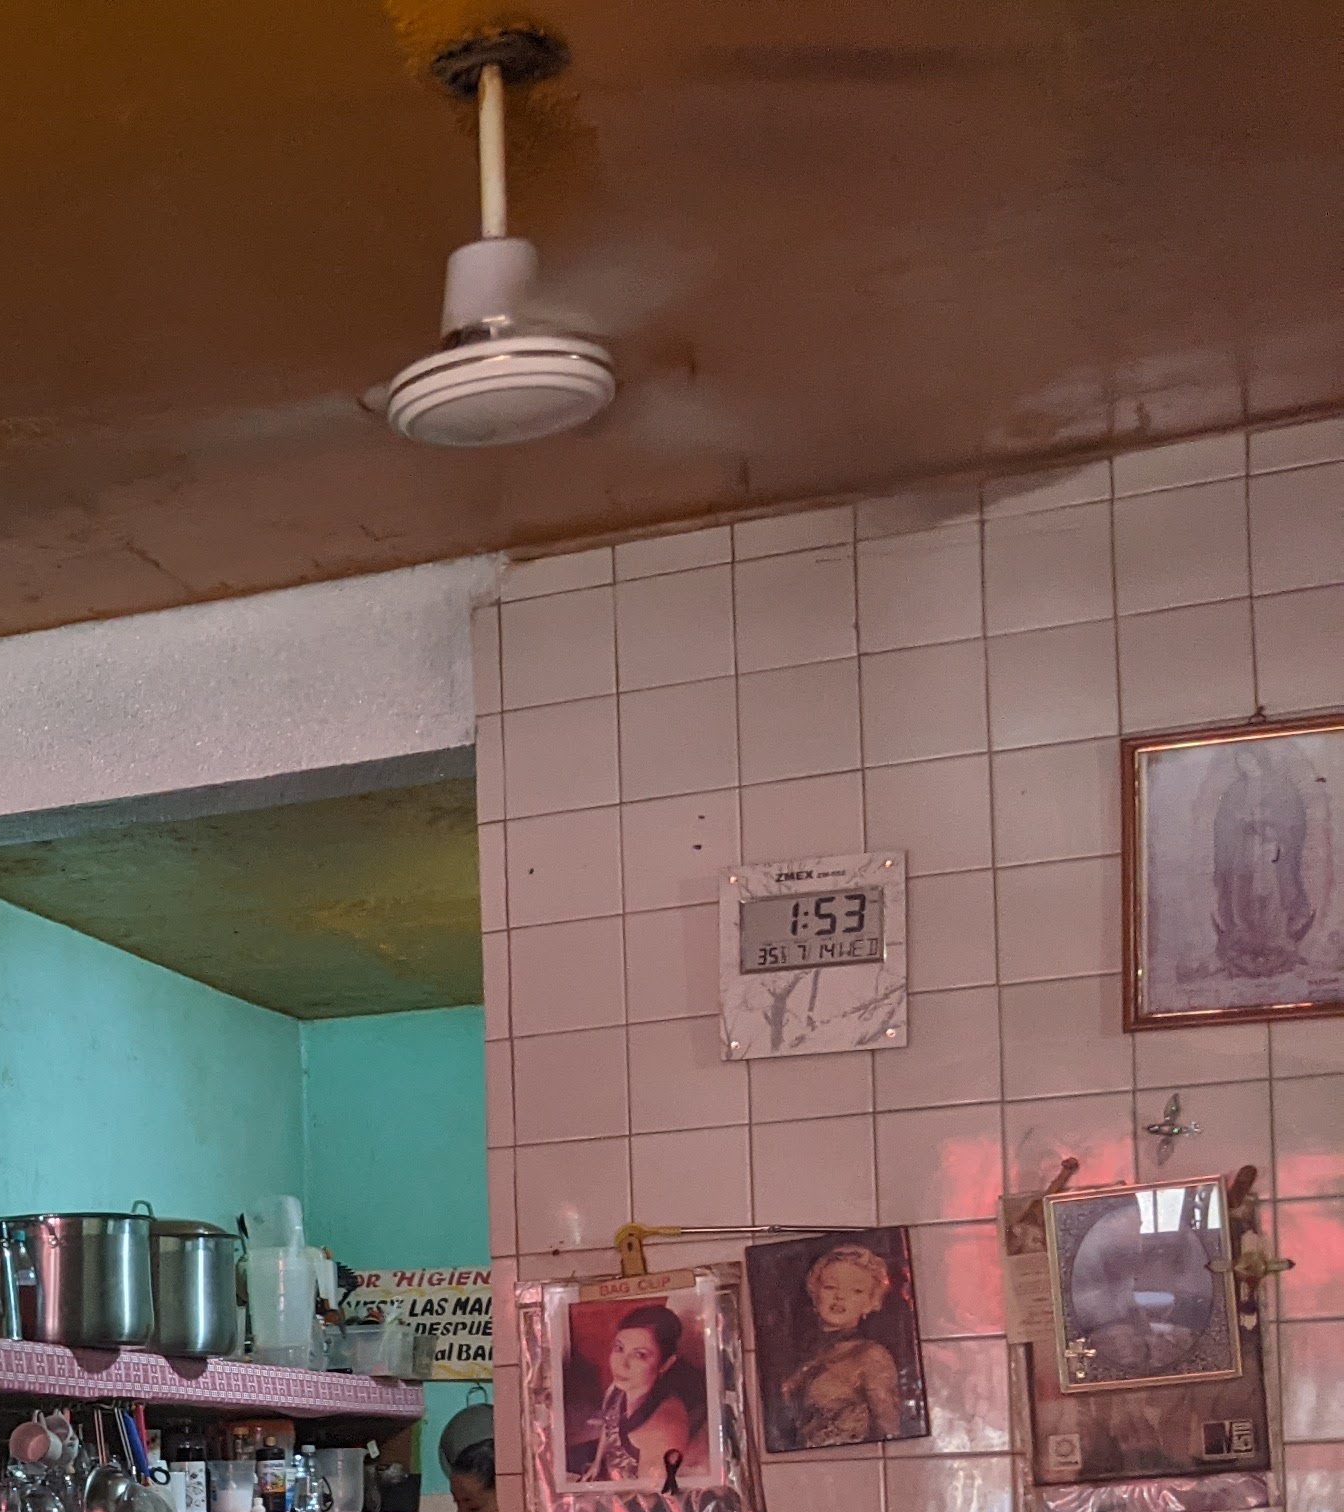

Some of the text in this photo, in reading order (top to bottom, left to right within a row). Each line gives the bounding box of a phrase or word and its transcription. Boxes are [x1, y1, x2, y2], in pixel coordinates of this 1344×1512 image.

[776, 870, 814, 883] ZMEX
[790, 894, 866, 936] 1:53
[354, 1272, 381, 1288] OR
[600, 1281, 630, 1296] BAG
[409, 1297, 448, 1317] LAS
[434, 1342, 453, 1361] al
